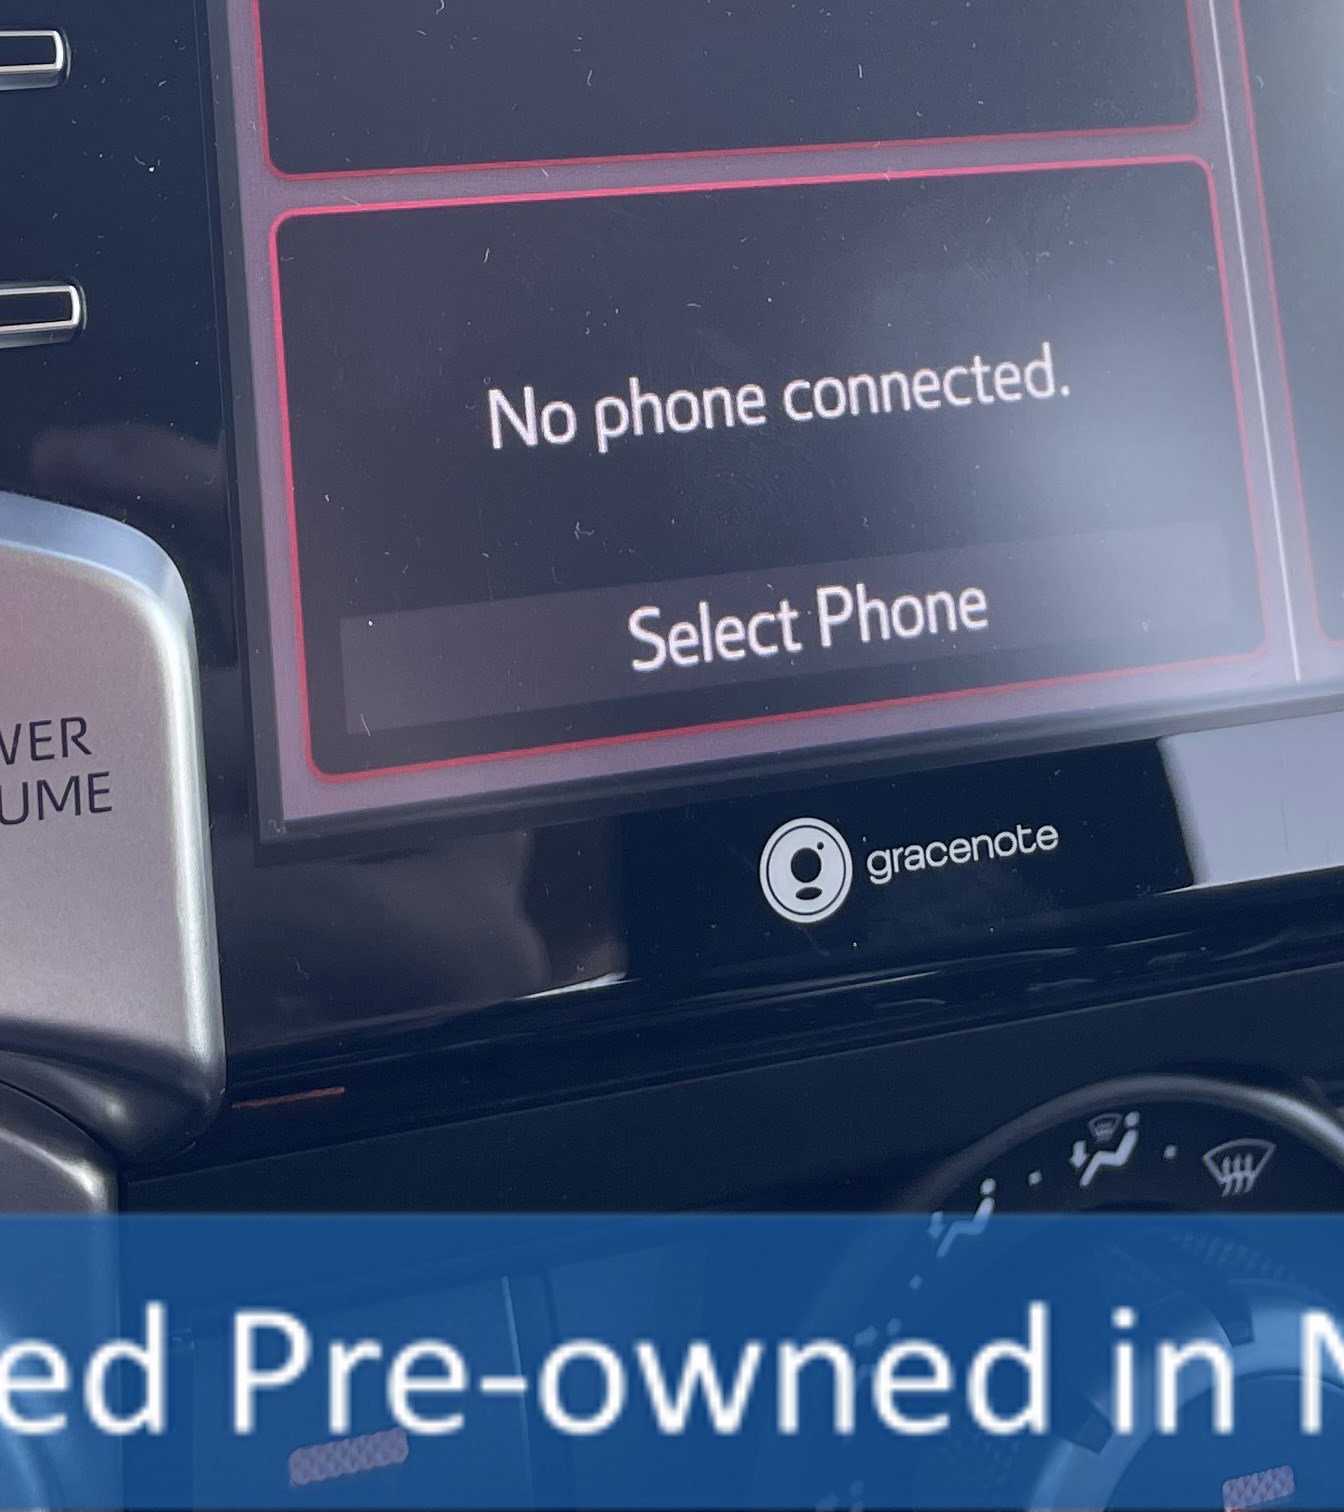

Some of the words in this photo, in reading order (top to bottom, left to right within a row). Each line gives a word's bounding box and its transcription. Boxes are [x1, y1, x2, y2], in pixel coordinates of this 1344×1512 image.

[487, 384, 578, 451] No
[595, 376, 767, 455] phone
[783, 341, 1071, 424] connected.
[626, 600, 799, 673] Select
[816, 582, 990, 649] Phone
[866, 823, 1059, 886] gracenote
